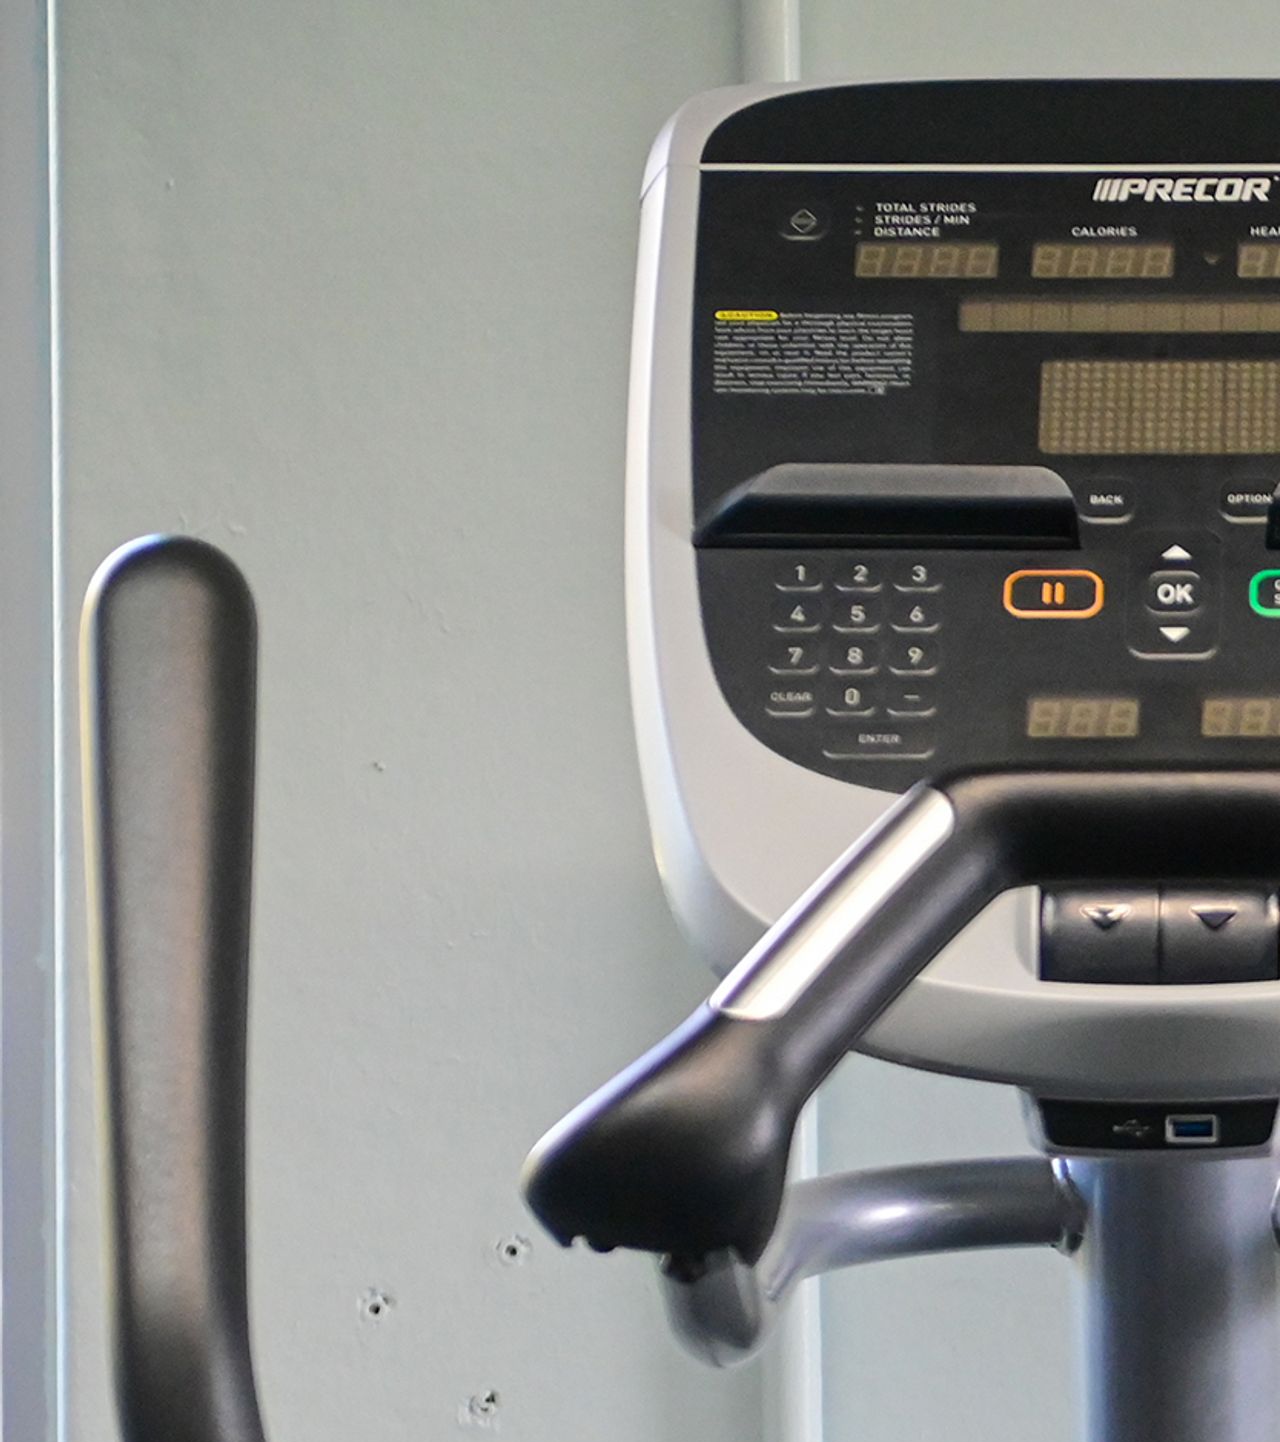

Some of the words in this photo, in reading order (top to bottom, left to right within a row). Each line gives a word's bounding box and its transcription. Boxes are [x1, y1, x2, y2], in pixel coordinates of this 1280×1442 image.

[1112, 177, 1272, 202] PRECOR
[876, 202, 916, 213] TOTAL
[919, 202, 977, 213] STRIDES
[874, 214, 931, 225] STRIDES
[943, 214, 970, 225] MIN
[874, 226, 941, 237] DISTANCE
[1071, 226, 1138, 237] CALORIES
[1089, 494, 1124, 505] BACK
[795, 564, 806, 582] 1
[853, 564, 869, 583] 2
[911, 565, 928, 583] 3
[1157, 583, 1195, 604] OK
[790, 605, 806, 622] 4
[850, 604, 866, 623] 5
[909, 605, 925, 623] 6
[787, 646, 804, 665] 7
[847, 646, 863, 665] 8
[907, 646, 924, 665] 9
[770, 691, 813, 702] CLEAR
[844, 688, 861, 705] 0
[858, 733, 901, 745] ENTER
